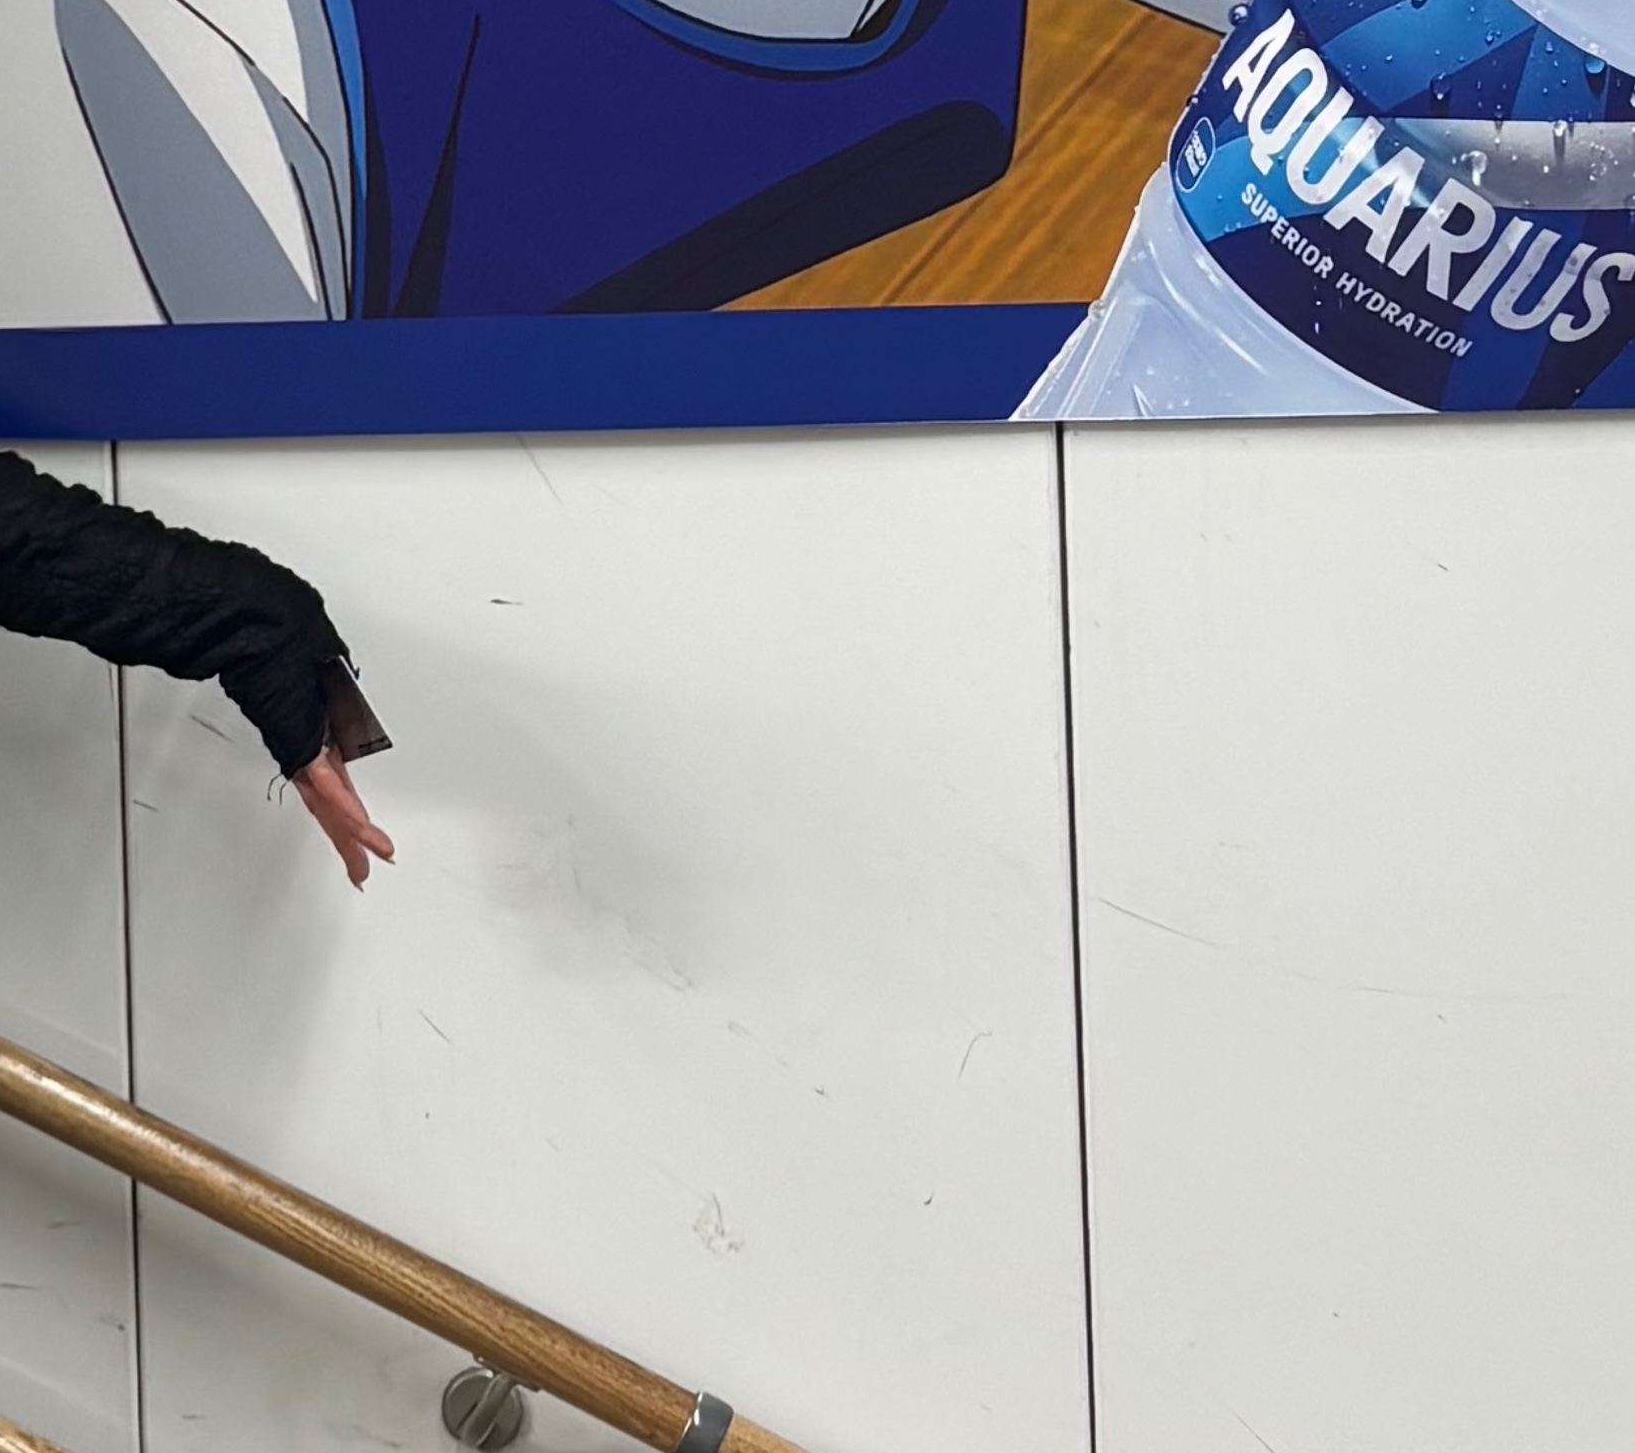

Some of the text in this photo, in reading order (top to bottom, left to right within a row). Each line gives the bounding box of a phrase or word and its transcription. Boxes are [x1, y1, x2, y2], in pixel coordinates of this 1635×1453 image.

[1221, 8, 1635, 343] AQUARIUS
[1241, 183, 1473, 358] SUPERIOR HYDRATION
